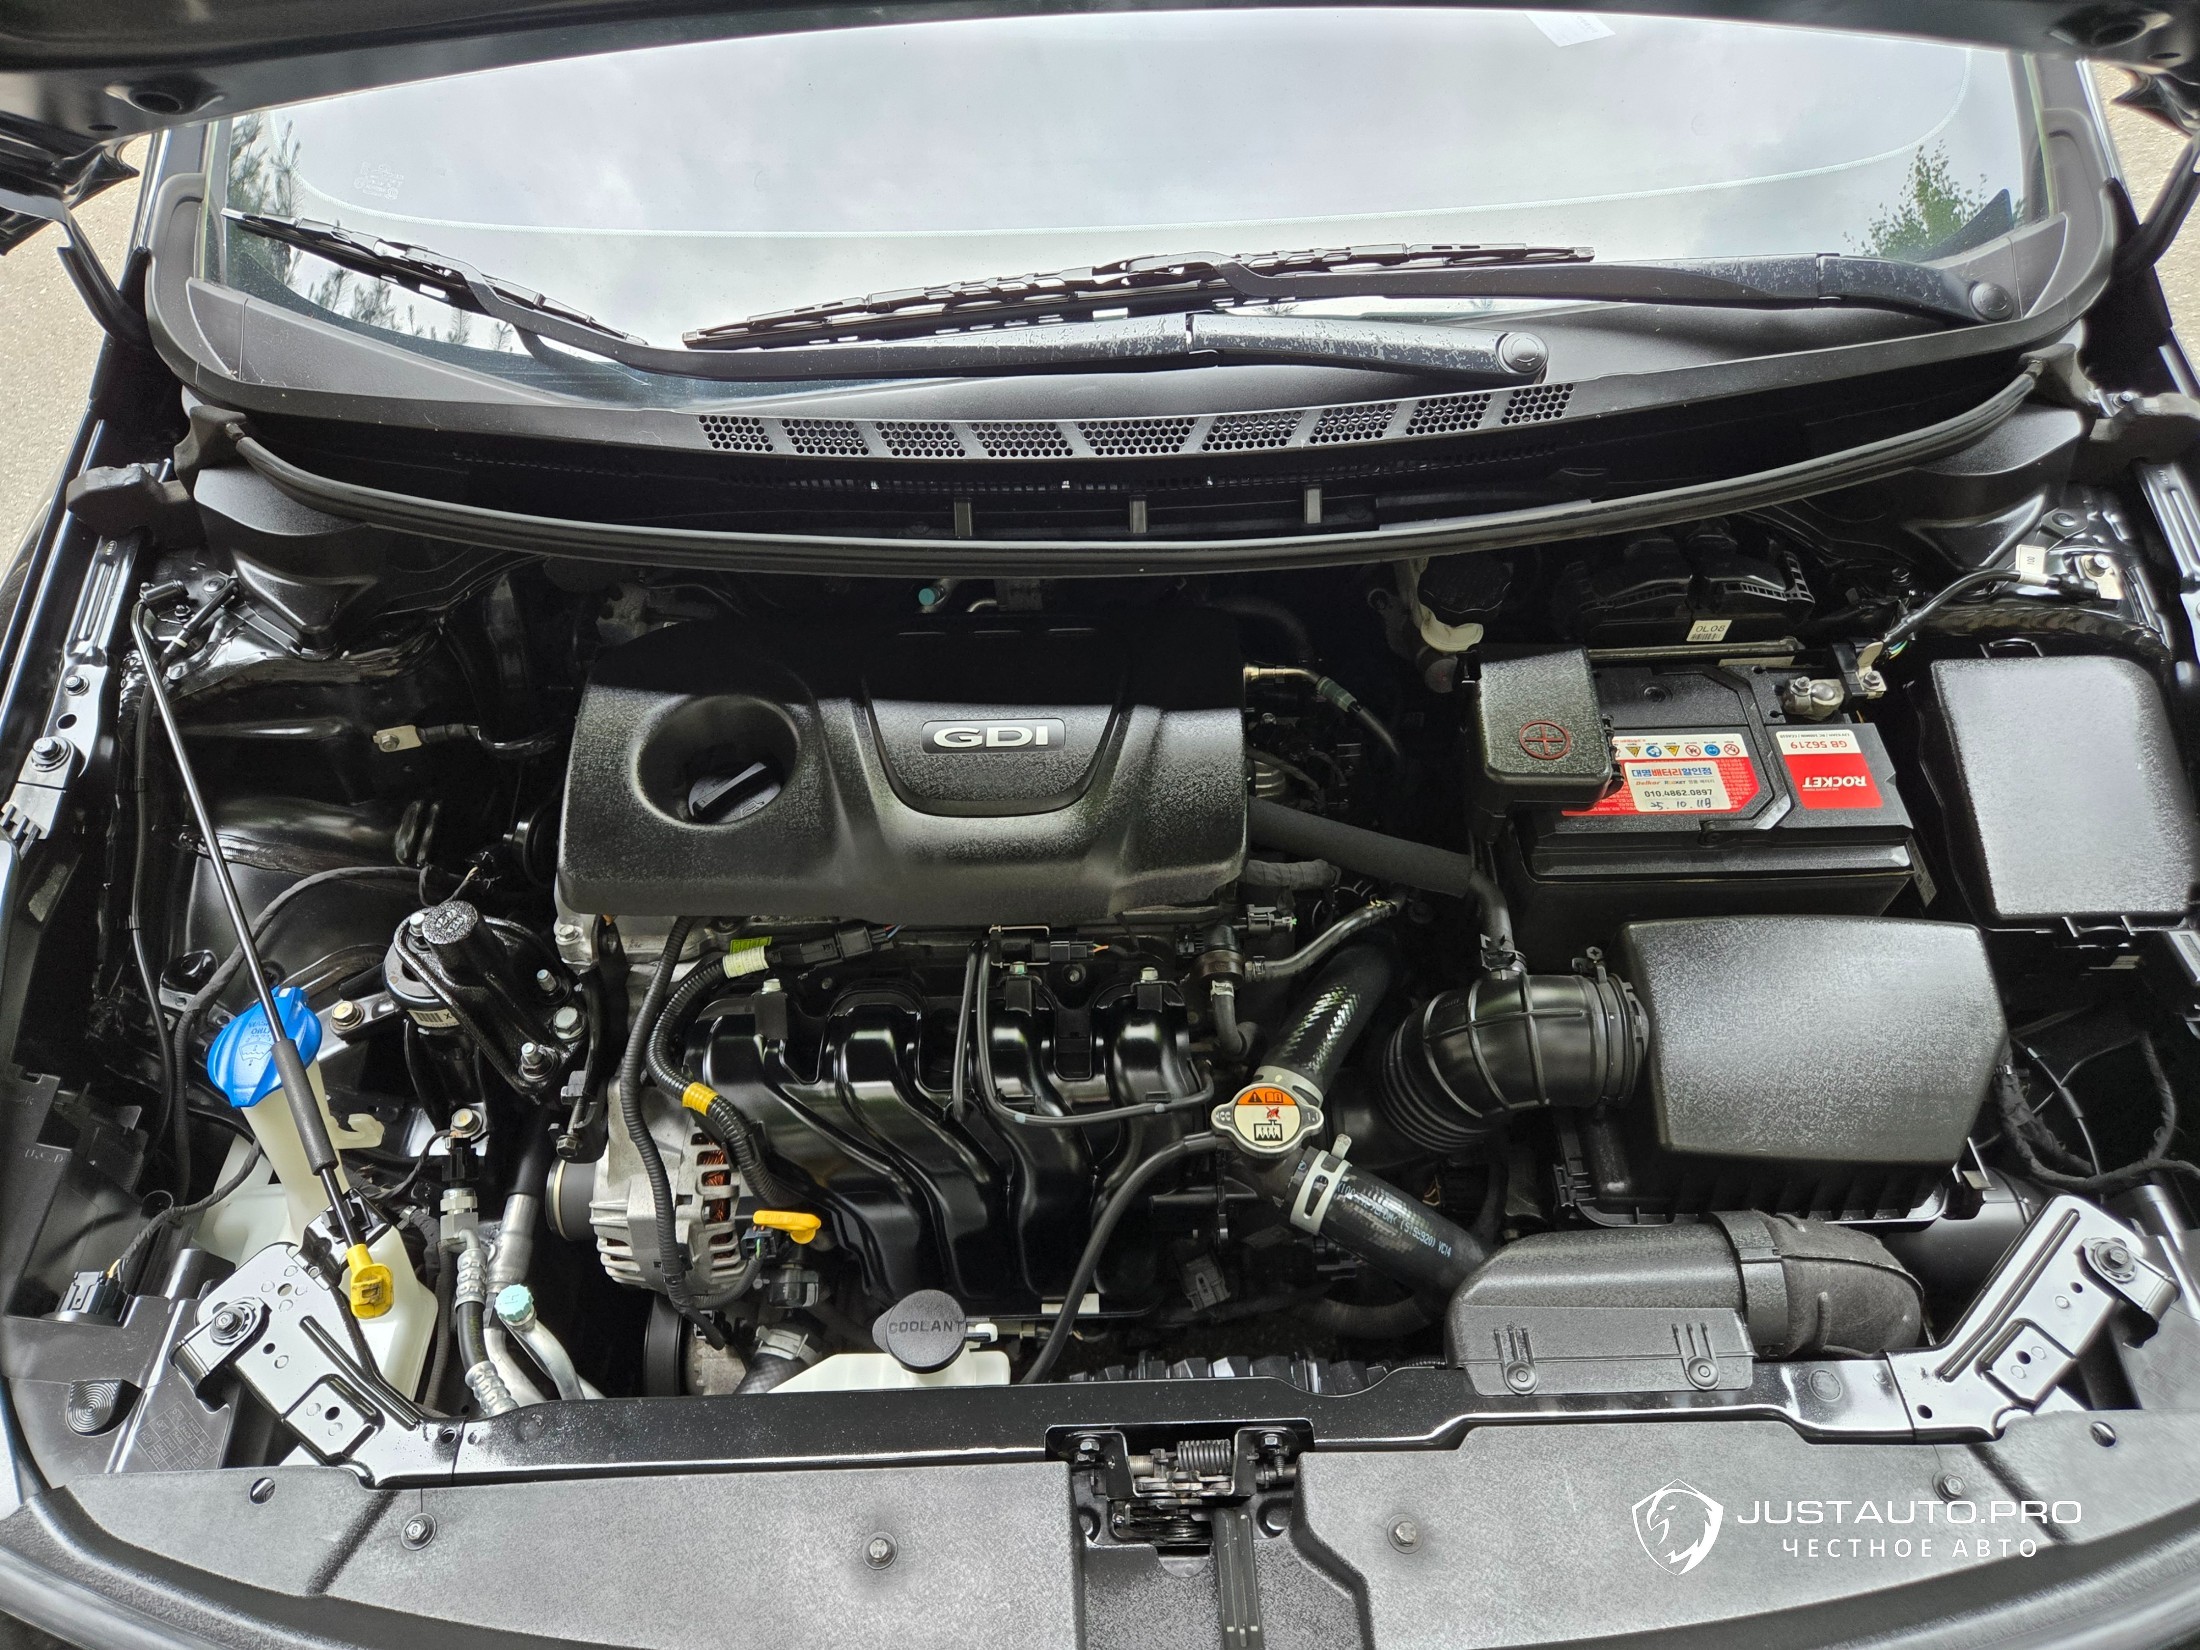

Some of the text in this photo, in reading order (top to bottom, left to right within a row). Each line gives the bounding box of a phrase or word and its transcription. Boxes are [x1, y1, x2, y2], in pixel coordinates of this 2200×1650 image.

[933, 725, 1049, 748] GDI
[1790, 740, 1848, 749] GB 56219
[1802, 775, 1867, 788] ROCKET
[1644, 788, 1713, 798] 010.4862.0897
[889, 1320, 966, 1335] COOLANT
